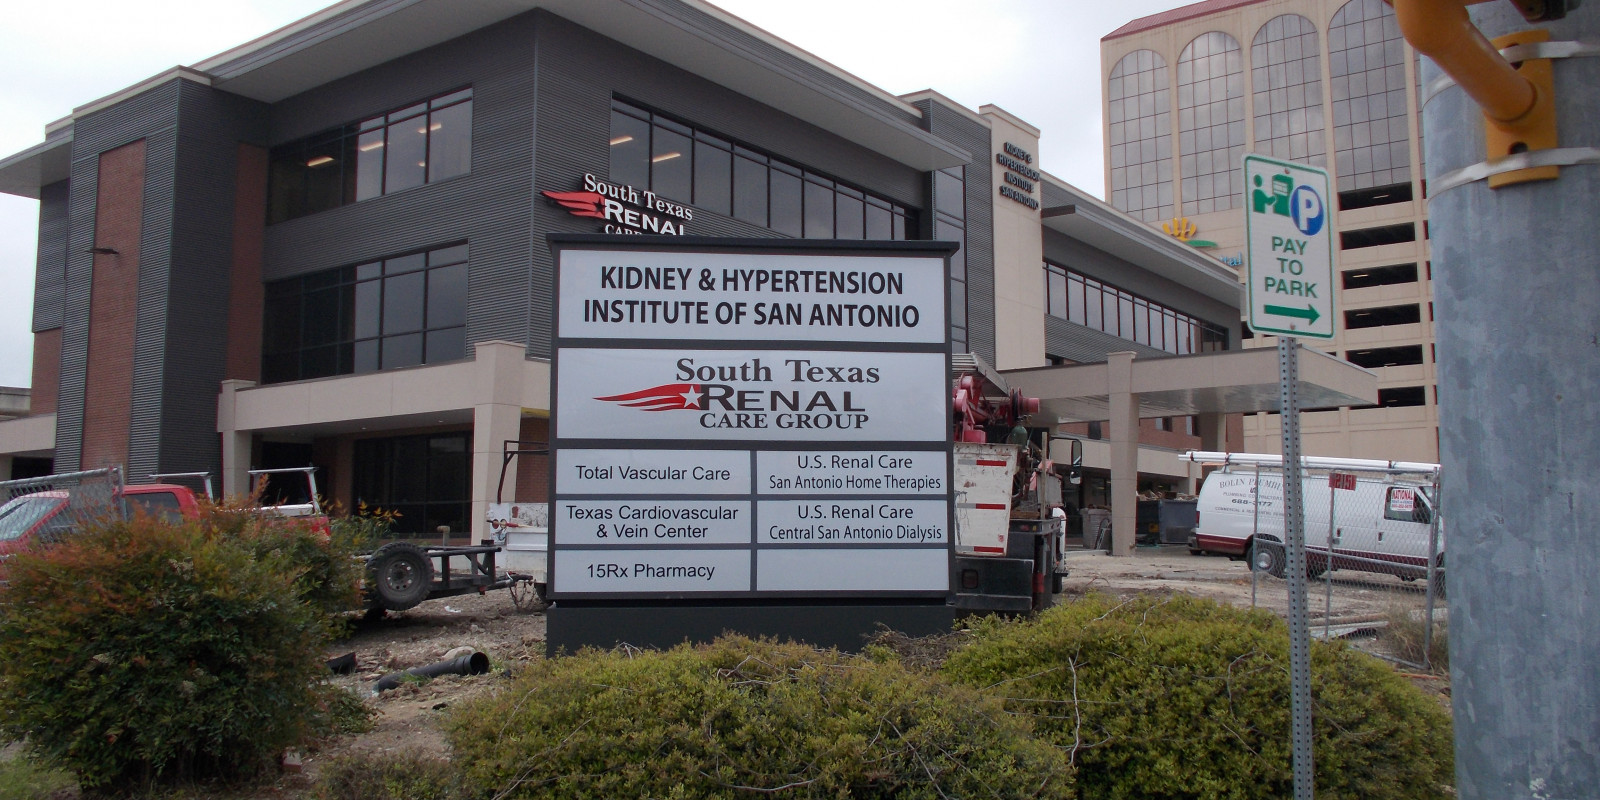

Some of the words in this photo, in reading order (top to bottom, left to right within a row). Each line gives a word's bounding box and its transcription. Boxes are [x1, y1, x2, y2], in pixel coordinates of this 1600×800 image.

[1004, 172, 1034, 193] INSTITUTE
[584, 173, 638, 205] South
[643, 190, 693, 221] Texas
[1298, 189, 1319, 231] P
[1272, 236, 1307, 255] PAY
[1277, 258, 1303, 275] TO
[601, 265, 693, 291] KIDNEY
[698, 267, 716, 292] &
[722, 268, 903, 295] HYPERTENSION
[1265, 277, 1318, 298] PARK
[584, 299, 709, 325] INSTITUTE
[714, 301, 748, 325] OF
[753, 302, 802, 326] SAN
[808, 303, 920, 328] ANTONIO
[675, 357, 774, 382] South
[784, 359, 880, 384] Texas
[700, 383, 866, 413] RENAL
[699, 412, 769, 429] CARE
[775, 413, 870, 430] GROUP
[797, 454, 827, 469] U.S.
[831, 453, 874, 469] Renal
[877, 454, 913, 469] Care
[574, 465, 613, 480] Total
[618, 465, 688, 481] Vascular
[692, 465, 731, 481] Care
[769, 474, 791, 489] San
[794, 474, 843, 489] Antonio
[846, 474, 882, 489] Home
[883, 474, 941, 493] Therapies
[1219, 478, 1244, 488] BOLIN
[1392, 489, 1413, 500] NATIONAL
[565, 504, 614, 520] Texas
[620, 504, 740, 520] Cardiovascular
[797, 504, 827, 520] U.S.
[831, 503, 874, 519] Renal
[878, 504, 914, 519] Care
[596, 523, 609, 539] &
[613, 523, 649, 539] Vein
[653, 523, 709, 539] Center
[769, 524, 814, 540] Central
[817, 524, 840, 540] San
[843, 524, 894, 540] Antonio
[896, 524, 942, 544] Dialysis
[587, 563, 629, 579] 15Rx
[633, 563, 716, 581] Pharmacy
